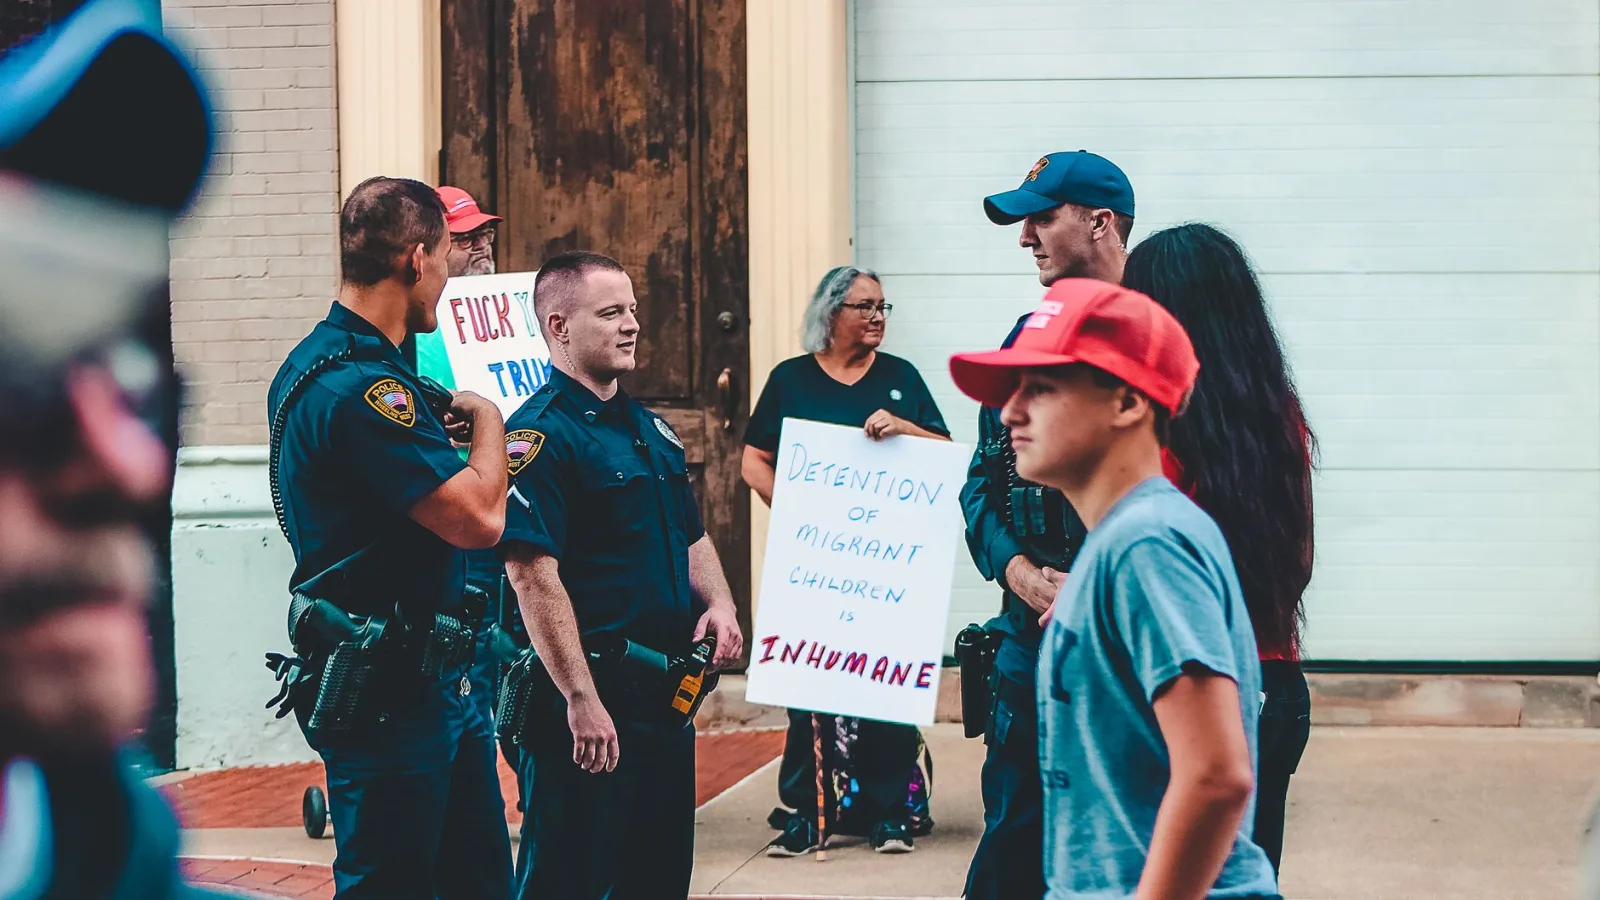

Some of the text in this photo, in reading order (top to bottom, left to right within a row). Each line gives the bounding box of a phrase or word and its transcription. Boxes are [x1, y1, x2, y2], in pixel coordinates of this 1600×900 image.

[450, 291, 539, 344] FUCK Y
[488, 357, 553, 397] TRUM
[788, 443, 943, 505] DETENTION
[848, 506, 880, 524] OF
[796, 523, 924, 565] MIGRANT
[789, 565, 906, 604] CHILDREN
[758, 634, 936, 690] INHUMANE
